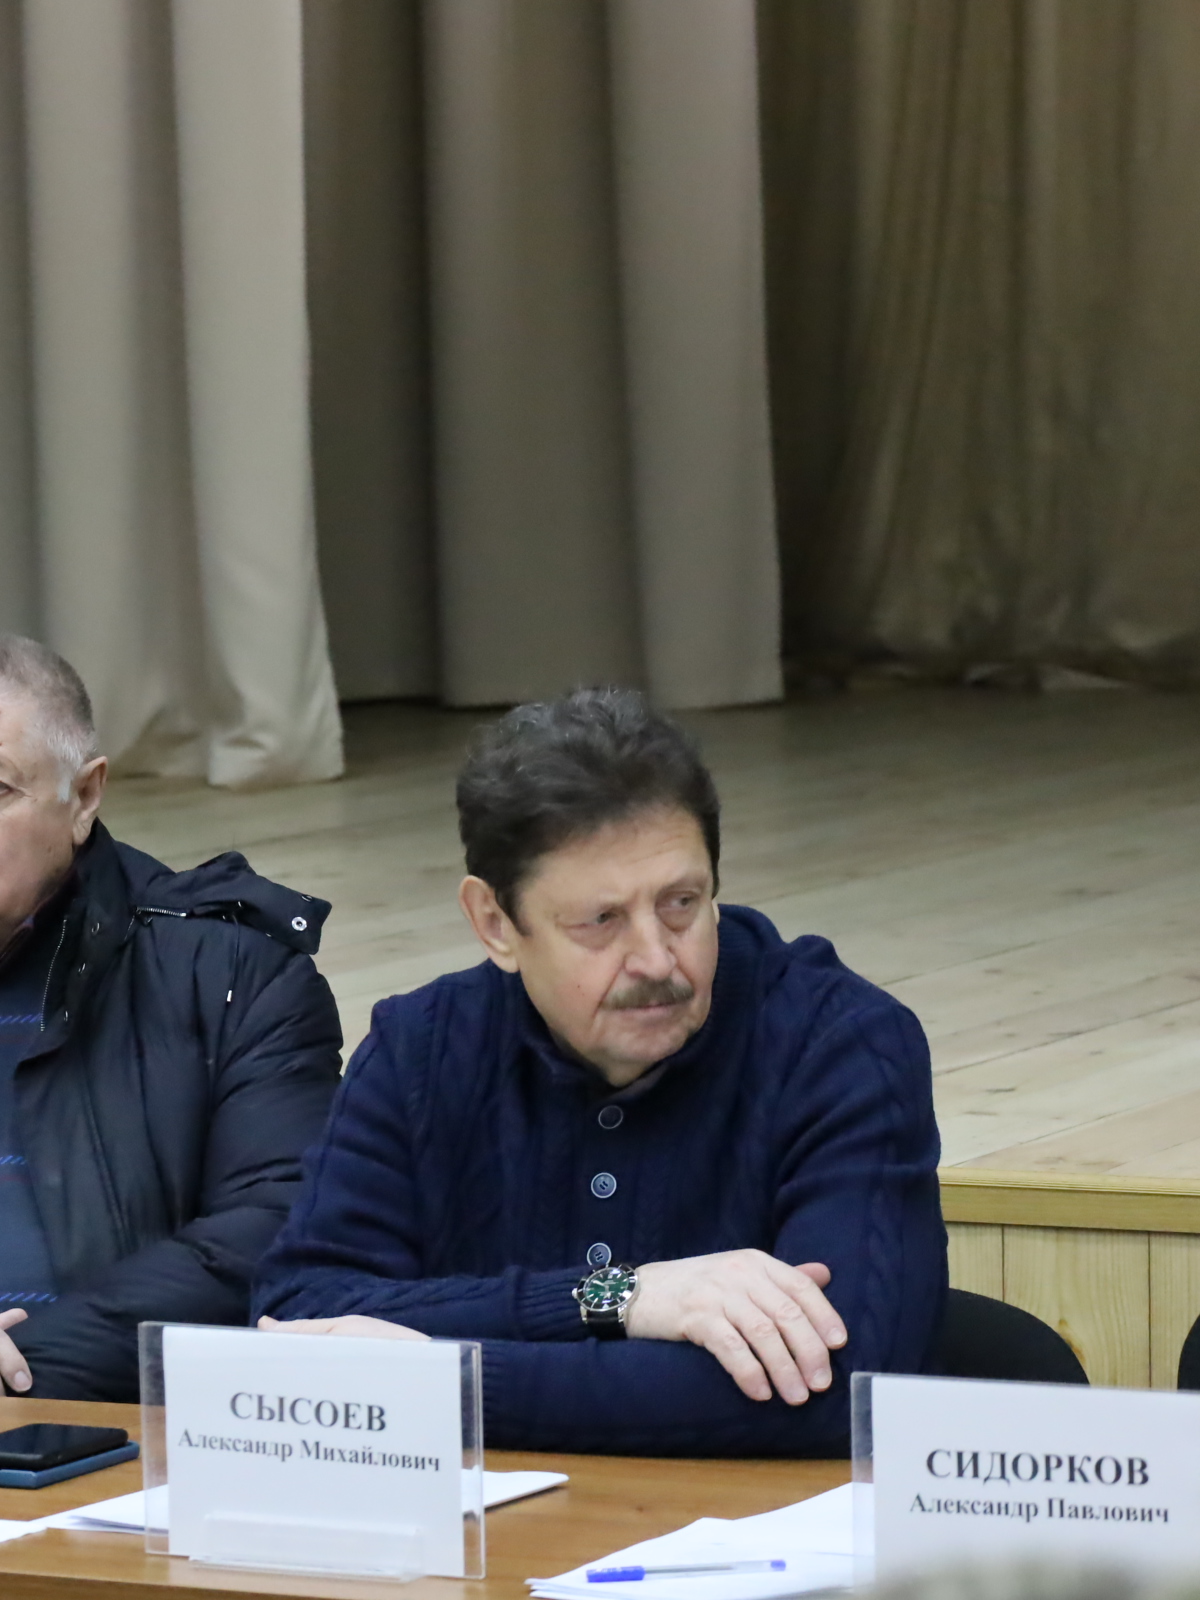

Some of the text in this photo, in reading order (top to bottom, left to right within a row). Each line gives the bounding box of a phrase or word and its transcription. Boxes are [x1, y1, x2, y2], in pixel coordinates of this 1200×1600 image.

[229, 1392, 387, 1432] СЫСОЕВ
[178, 1429, 440, 1472] Александр Михайлович
[925, 1448, 1150, 1486] СИДОРКОВ
[909, 1493, 1169, 1524] Александр Павлович
